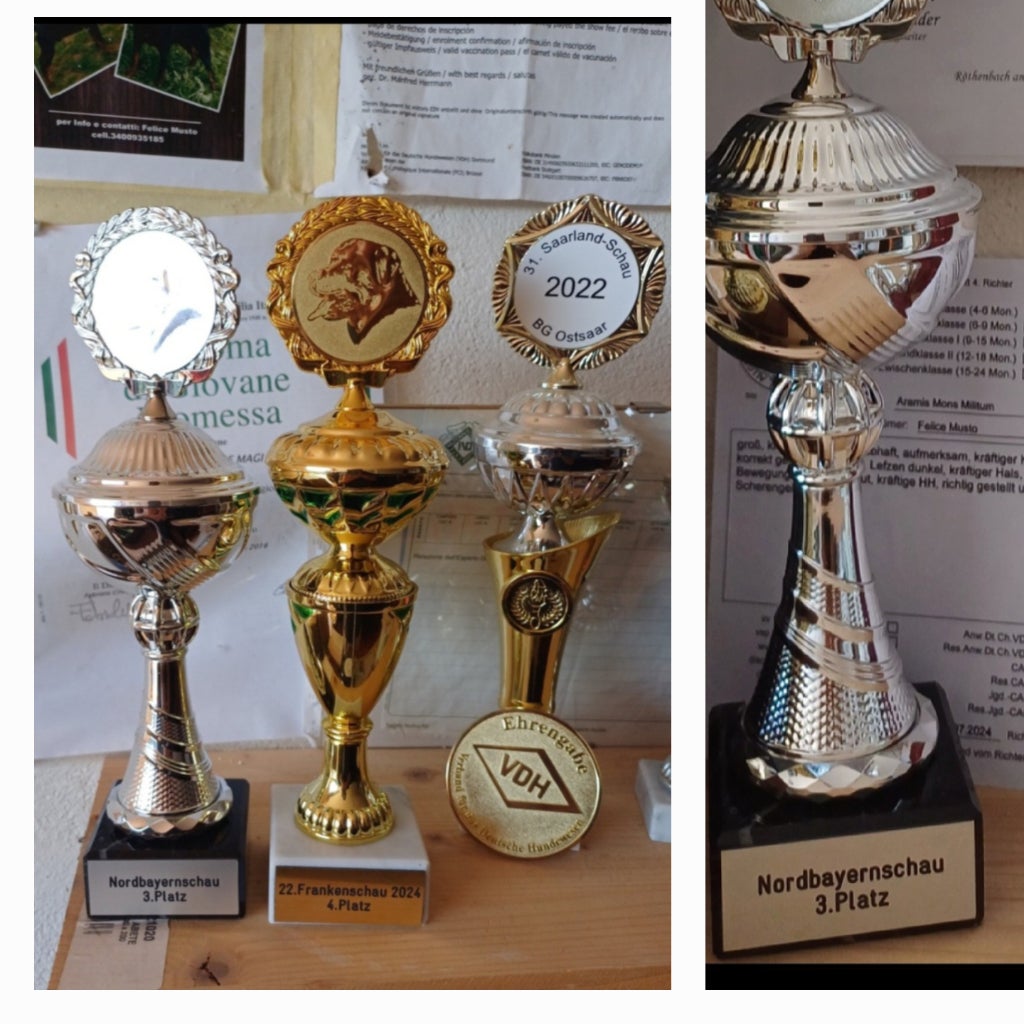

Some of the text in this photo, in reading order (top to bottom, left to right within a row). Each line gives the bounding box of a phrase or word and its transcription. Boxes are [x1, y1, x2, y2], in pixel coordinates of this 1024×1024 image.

[954, 70, 1010, 83] Röthenbach
[1012, 74, 1024, 82] an
[142, 124, 168, 133] Felice
[171, 127, 198, 136] Musto
[523, 230, 632, 279] 31. Saarland-Schau
[545, 276, 607, 299] 2022
[532, 318, 608, 343] BG Ostsaar
[896, 397, 930, 408] Aramis
[933, 400, 958, 410] Mons
[960, 400, 994, 412] Militum
[179, 404, 282, 429] omessa
[918, 421, 978, 434] Felice Musto
[903, 448, 970, 462] aufmerksam,
[974, 452, 1017, 466] kräftiger
[870, 461, 905, 473] Lefzen
[908, 463, 945, 475] dunkel,
[949, 465, 993, 478] kräftiger
[996, 467, 1022, 480] Hals,
[877, 476, 916, 489] kräftige
[942, 480, 974, 493] richtig
[977, 481, 1015, 495] gestellt
[502, 716, 588, 775] Ehrengabe
[500, 753, 552, 799] VDH
[109, 876, 220, 890] Nordbayernschau
[758, 857, 944, 896] Nordbayernschau
[143, 890, 187, 903] 3.Platz
[279, 883, 421, 898] 22.Frankenschau 2024
[327, 899, 371, 912] 4.Platz
[815, 890, 889, 915] 3.Platz
